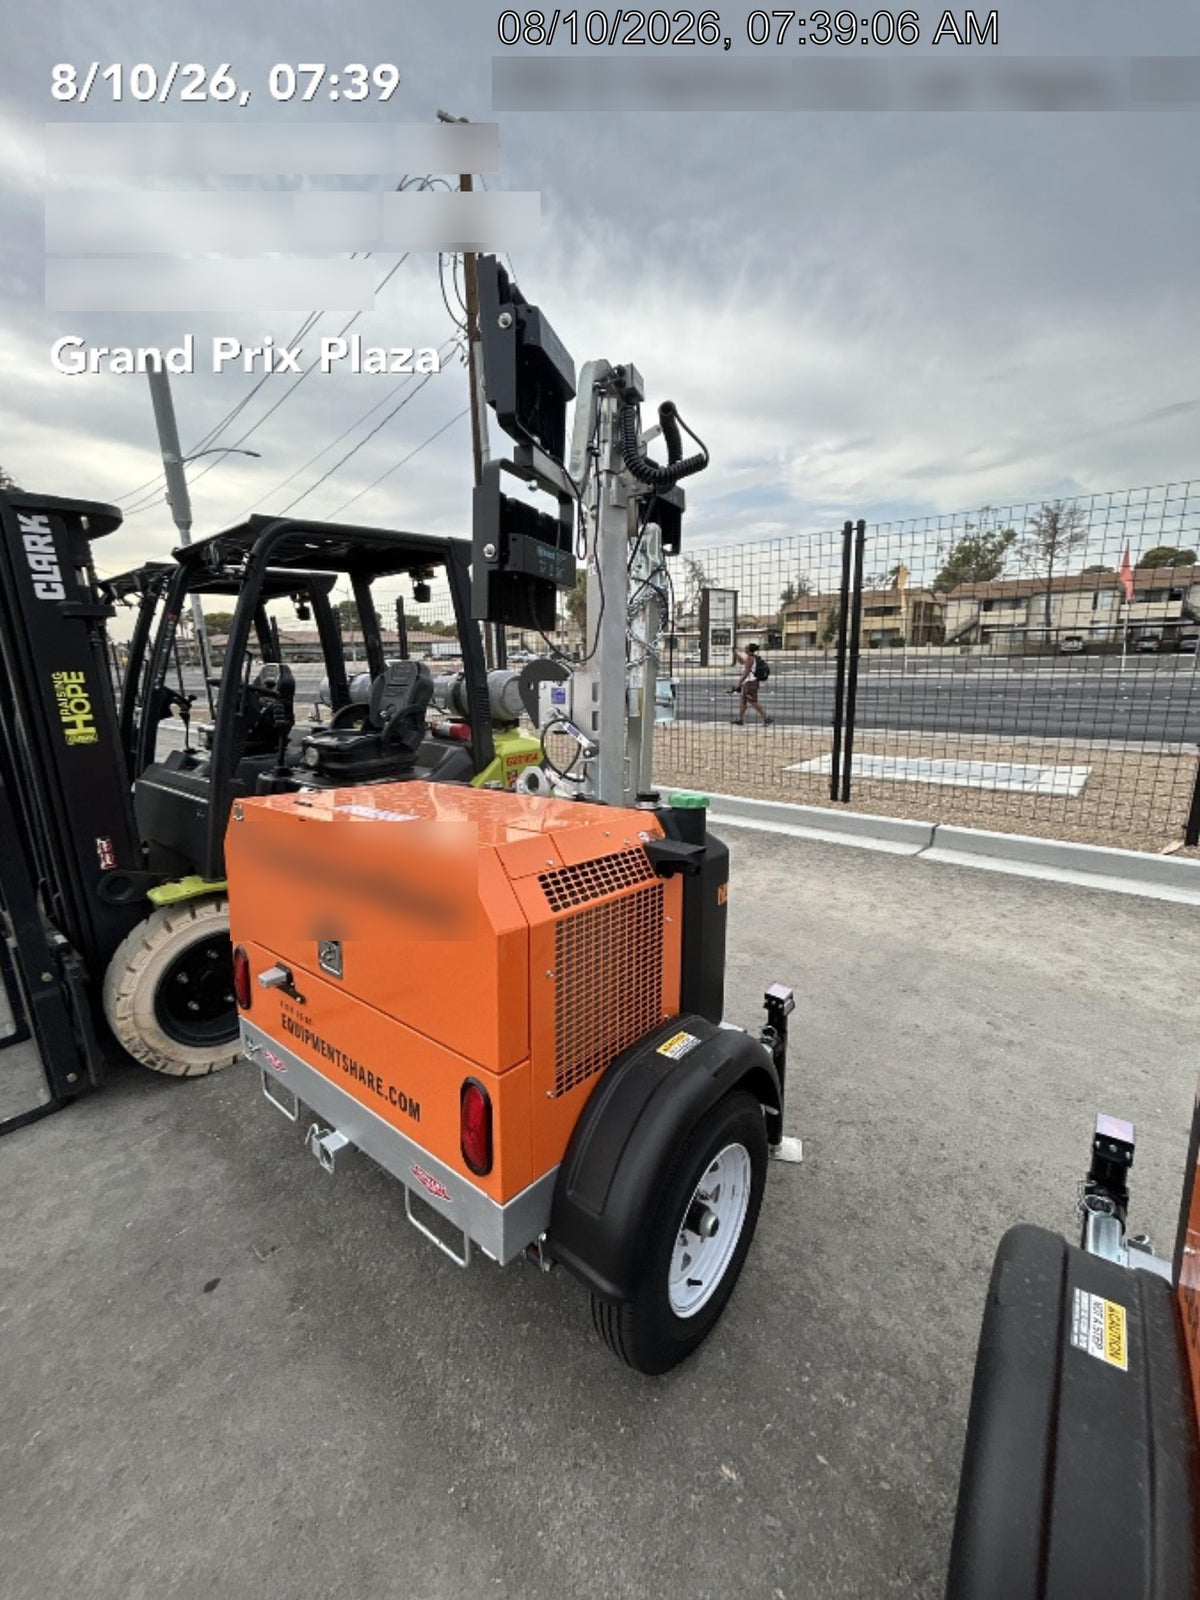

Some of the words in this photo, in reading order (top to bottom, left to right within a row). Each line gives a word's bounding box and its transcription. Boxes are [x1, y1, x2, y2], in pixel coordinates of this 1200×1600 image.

[17, 513, 67, 601] CLARK
[61, 671, 97, 735] HOPE
[280, 1013, 422, 1123] EQUIPMENTSHARE.COM
[1107, 1312, 1123, 1361] CAUTION
